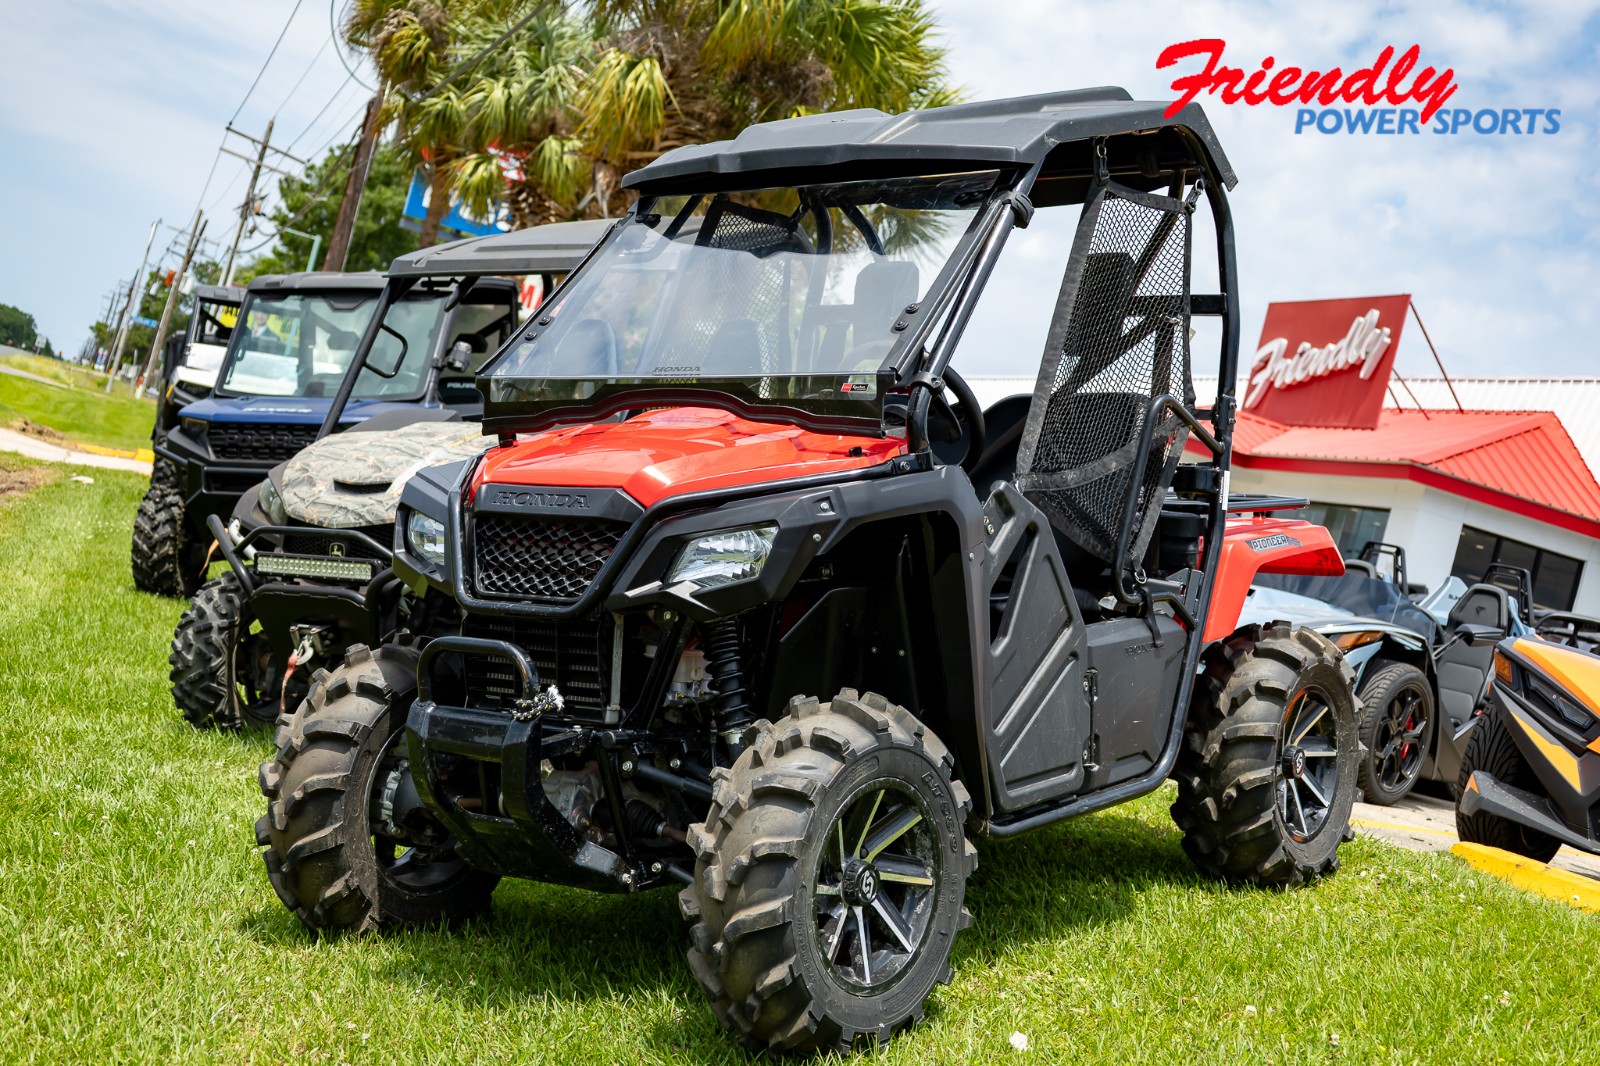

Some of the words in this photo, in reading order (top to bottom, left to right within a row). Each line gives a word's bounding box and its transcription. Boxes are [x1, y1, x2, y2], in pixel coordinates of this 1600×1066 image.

[1243, 307, 1392, 409] Friendly
[492, 490, 591, 510] HONDA
[1251, 534, 1289, 550] PIONEER
